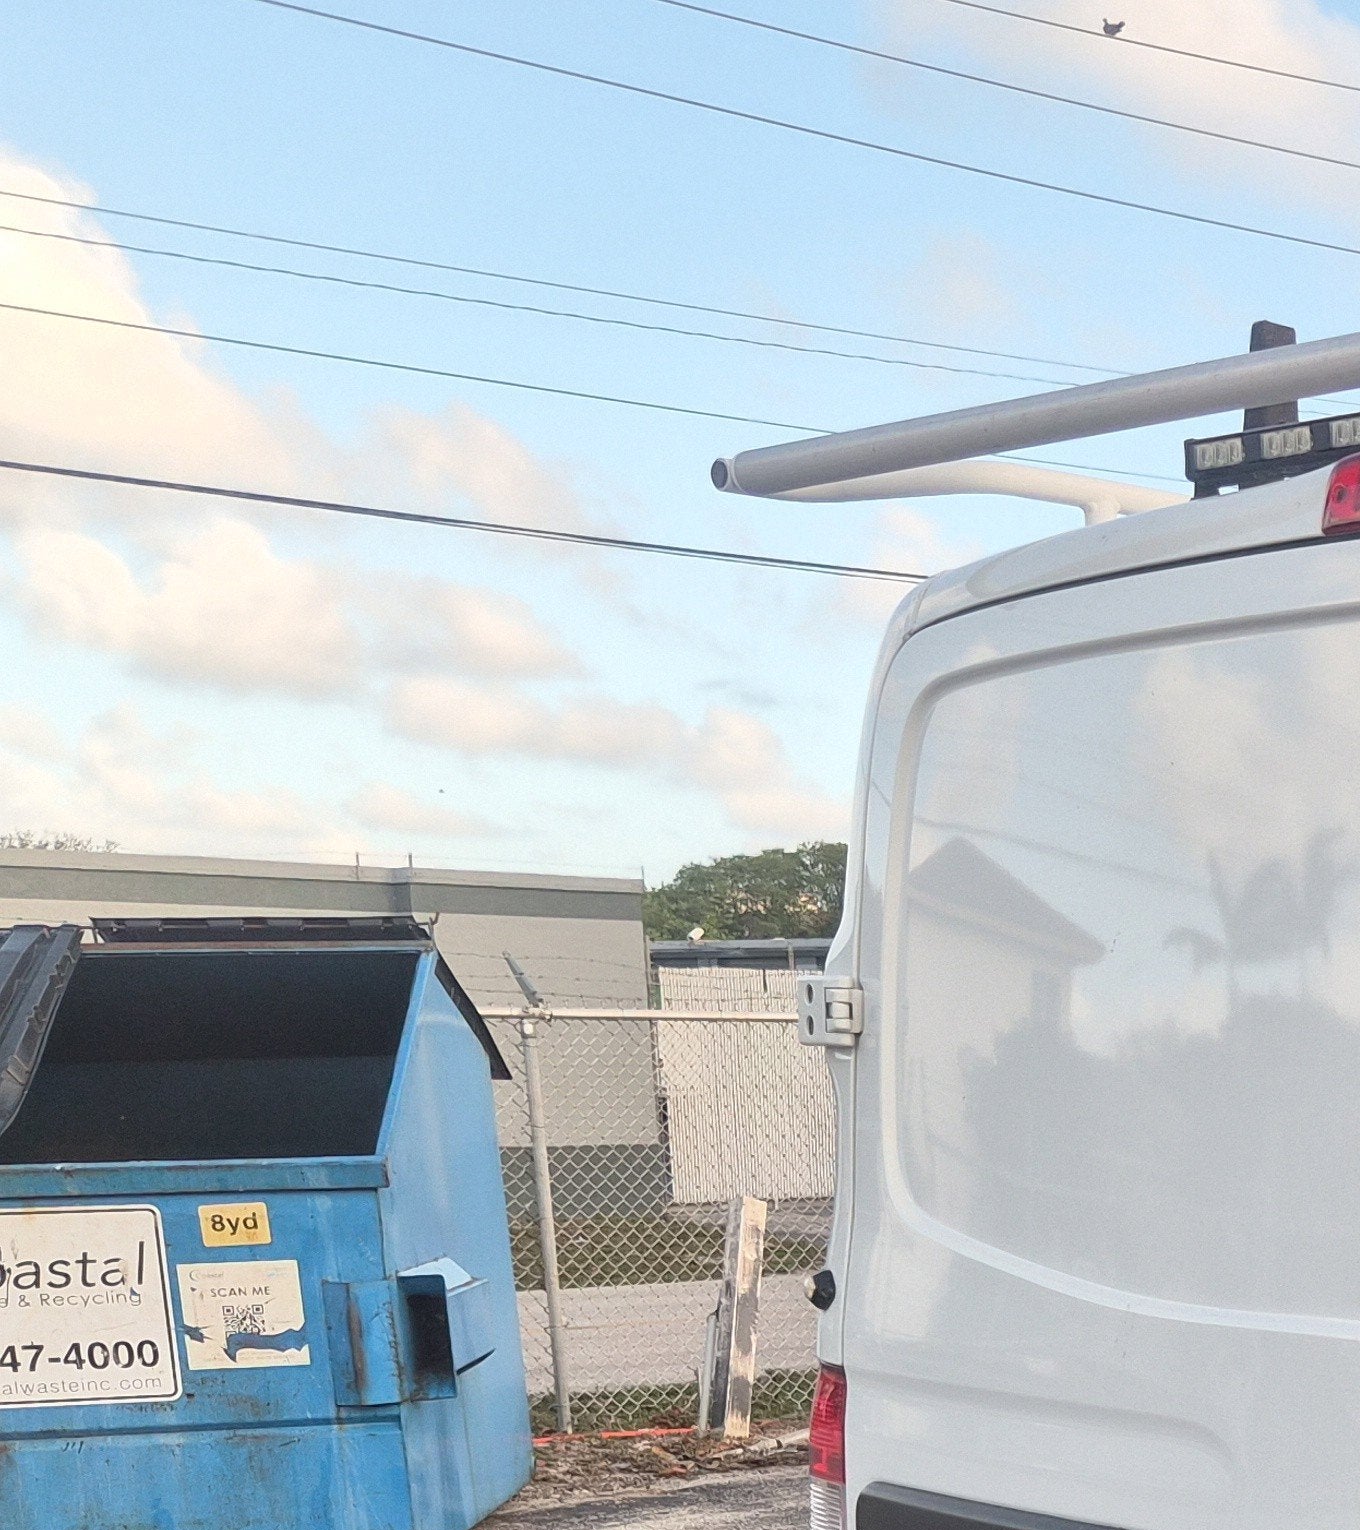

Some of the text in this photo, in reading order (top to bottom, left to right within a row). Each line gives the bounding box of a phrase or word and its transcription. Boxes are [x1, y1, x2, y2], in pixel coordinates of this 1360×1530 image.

[210, 1212, 259, 1236] 8yd
[18, 1294, 31, 1308] &
[40, 1290, 142, 1308] Recycling
[210, 1285, 271, 1298] SCAN ME
[0, 1339, 160, 1373] 47-4000
[2, 1377, 162, 1397] alwasteinc.com
